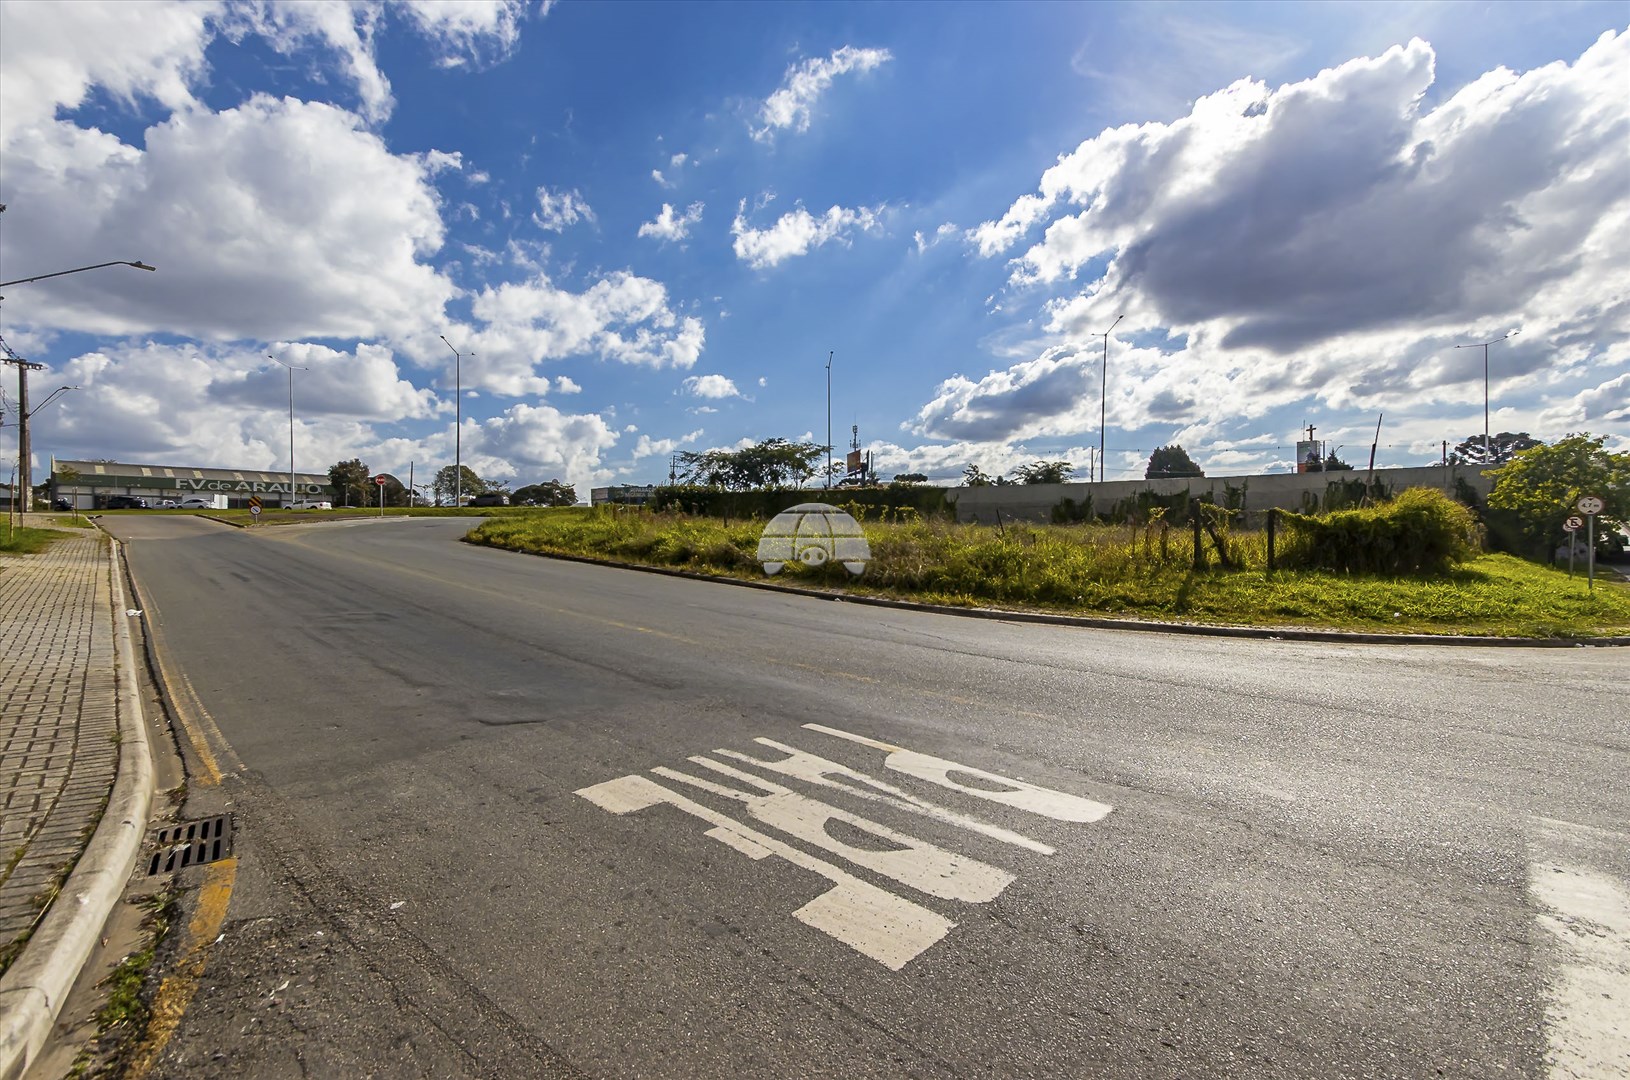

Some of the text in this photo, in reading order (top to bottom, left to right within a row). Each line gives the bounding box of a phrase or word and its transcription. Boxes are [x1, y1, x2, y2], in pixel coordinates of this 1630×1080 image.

[207, 481, 232, 491] de
[235, 481, 322, 494] ARAUJO
[572, 723, 1113, 972] PARE
